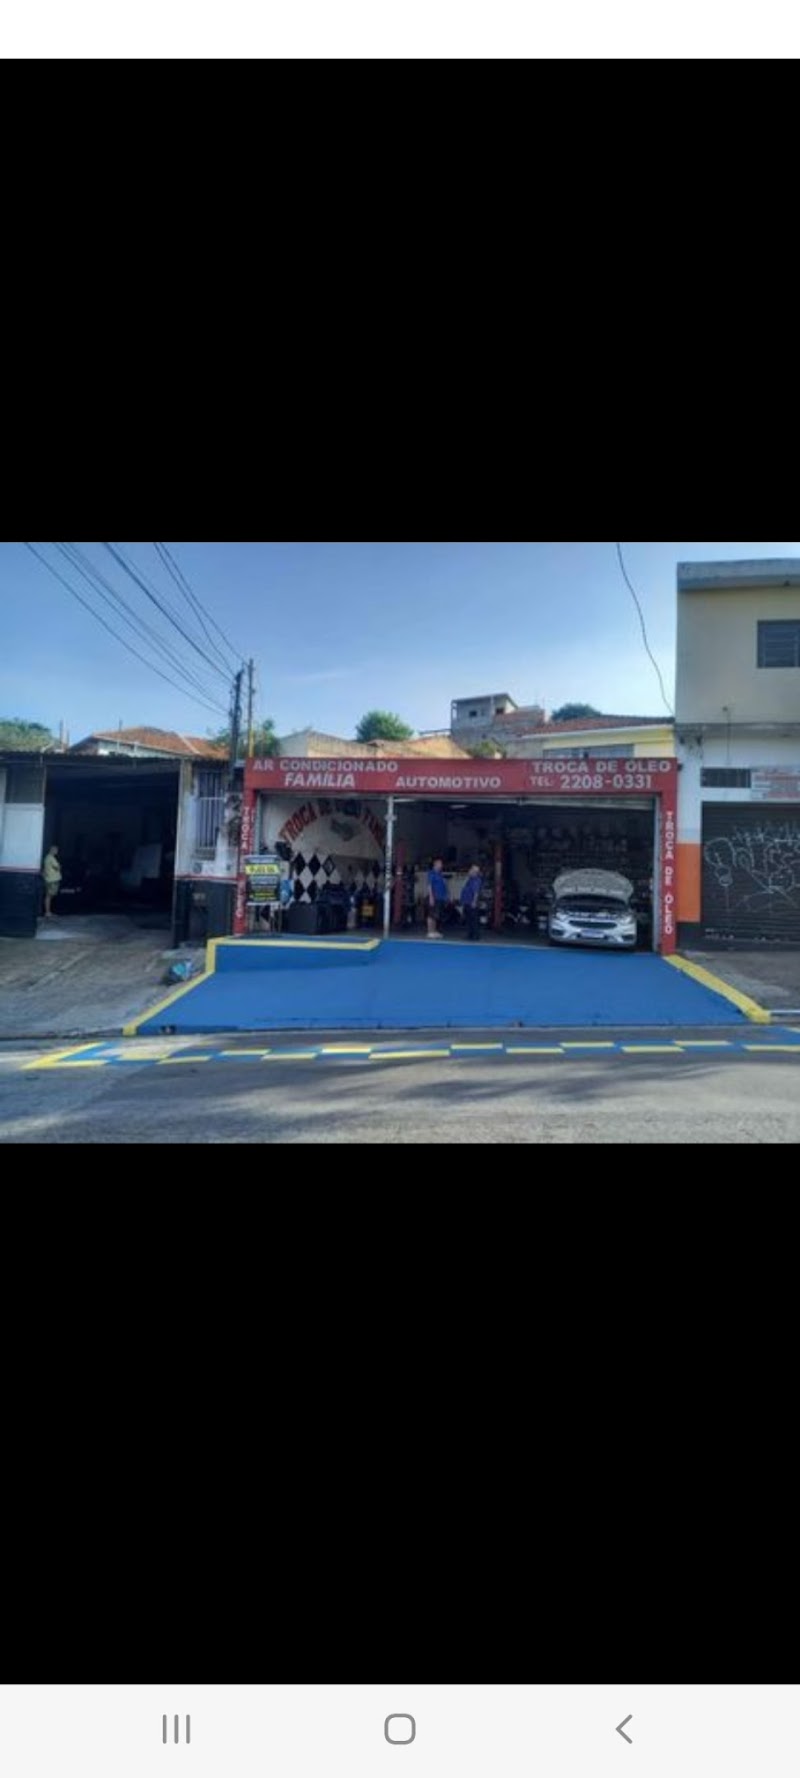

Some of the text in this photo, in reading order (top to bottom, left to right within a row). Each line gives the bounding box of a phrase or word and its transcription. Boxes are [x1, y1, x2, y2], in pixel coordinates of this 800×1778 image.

[253, 759, 398, 773] AR CONDICIONADO
[532, 760, 588, 773] TROCA
[596, 760, 618, 773] DE
[284, 771, 502, 789] FAMÍLIA AUTOMOTIVO
[560, 774, 652, 789] 2208-0331
[241, 807, 250, 850] TROCA
[665, 811, 674, 860] TROCA
[665, 866, 673, 885] DE
